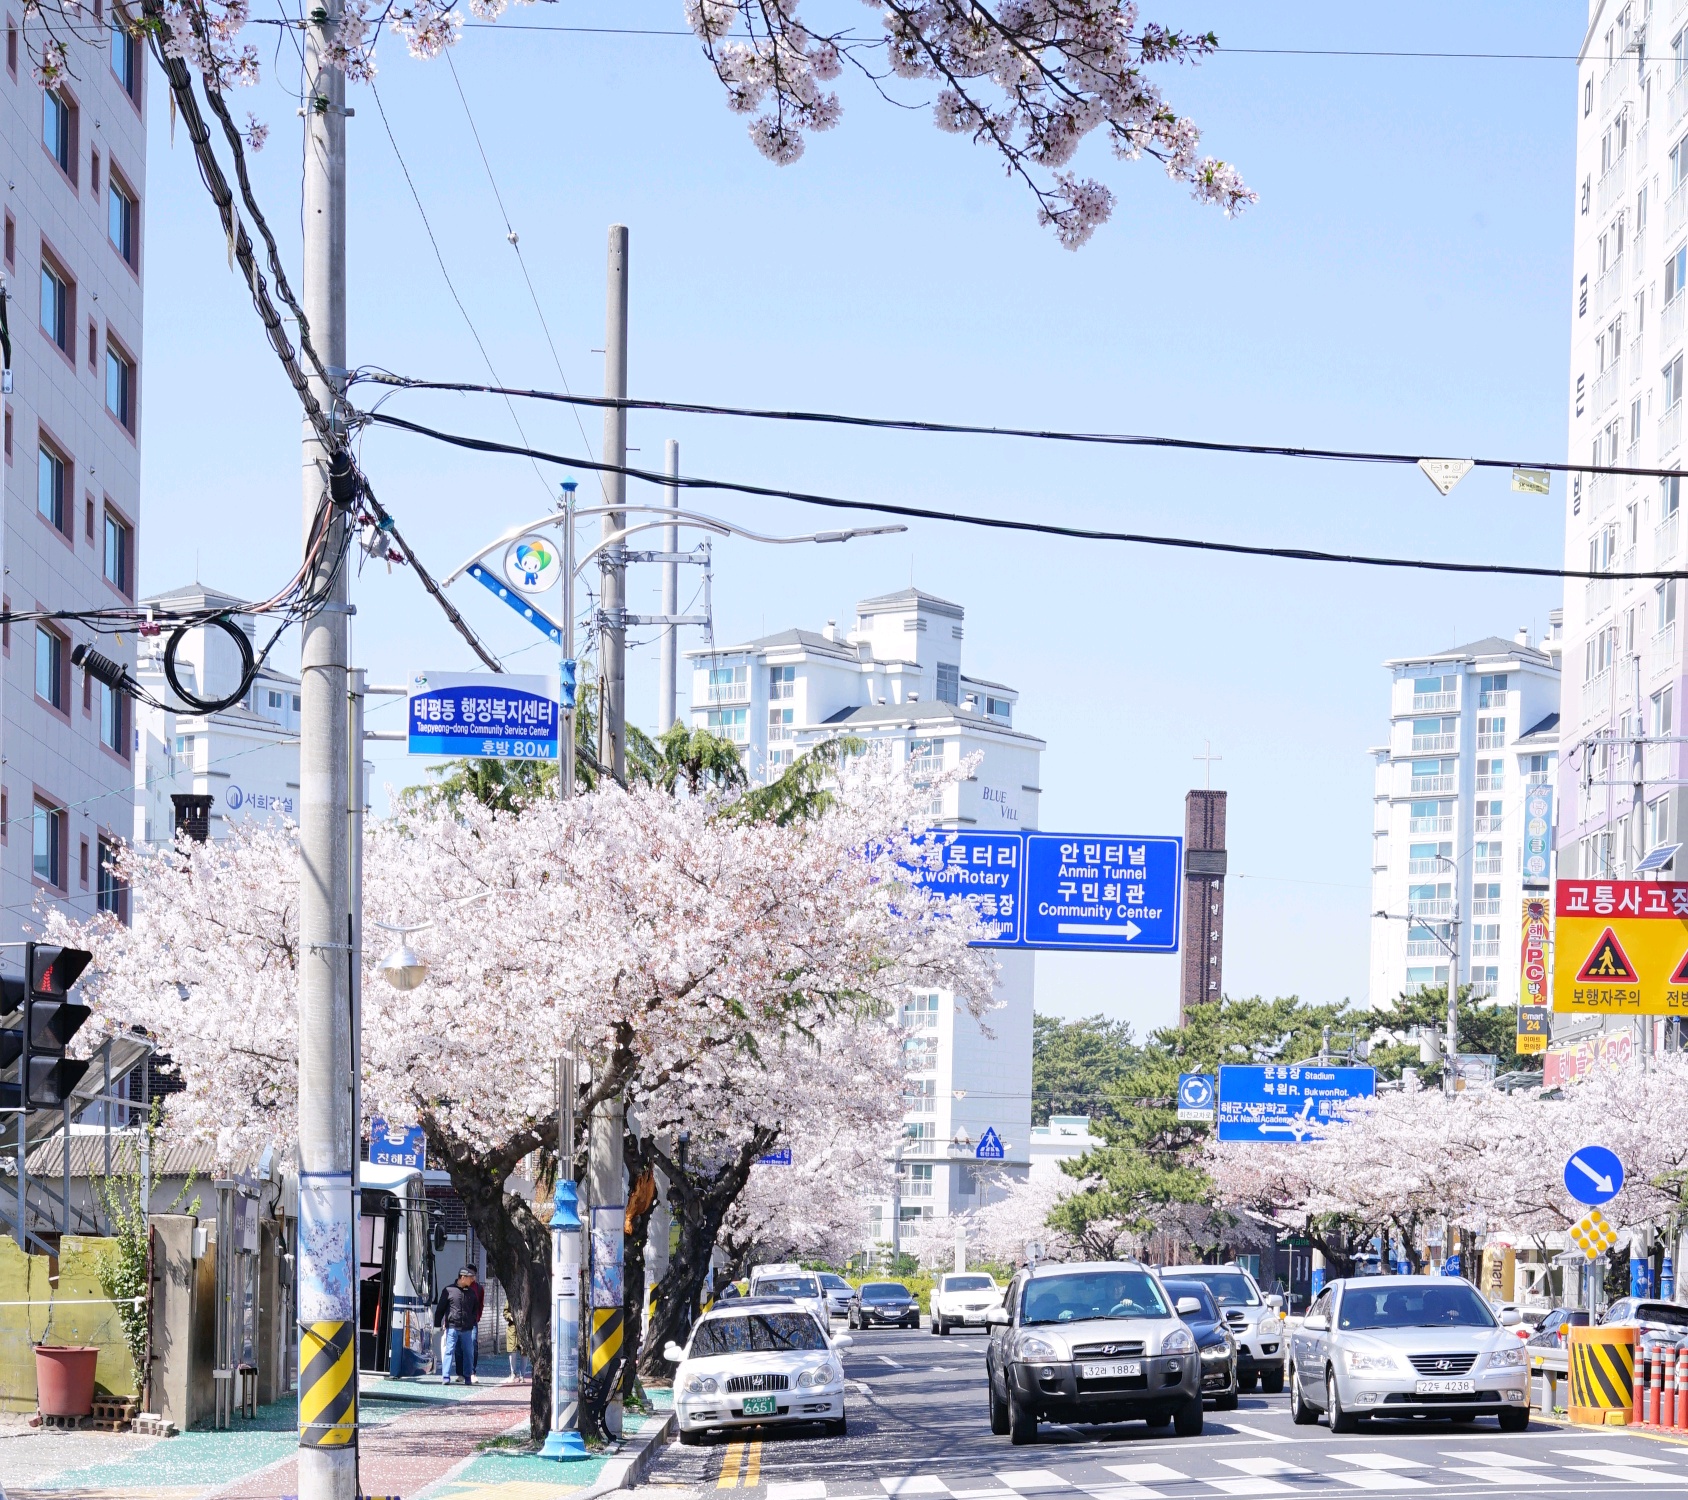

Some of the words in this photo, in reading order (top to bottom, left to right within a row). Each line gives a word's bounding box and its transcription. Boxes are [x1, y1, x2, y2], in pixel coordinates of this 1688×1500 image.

[414, 697, 456, 721] 태평동
[461, 697, 553, 724] 행정복지센터
[417, 721, 469, 735] Taepyeong-dong
[469, 723, 504, 736] Community
[504, 725, 528, 736] Service
[529, 726, 550, 737] Center
[481, 740, 510, 754] 후방
[513, 741, 550, 757] 80M
[983, 786, 1007, 804] BLUE
[1001, 805, 1018, 821] VILL
[1059, 842, 1147, 866] 안민터널
[959, 869, 1010, 889] Rotary
[1057, 864, 1099, 879] Anmin
[1102, 865, 1147, 880] Tunnel
[1057, 881, 1146, 904] 구민회관
[1038, 902, 1113, 921] Community
[1116, 904, 1163, 919] Center
[1571, 988, 1641, 1007] 보행자주의
[1522, 1012, 1544, 1020] emart
[1526, 1020, 1541, 1031] 24
[1263, 1066, 1301, 1080] 운동장
[1304, 1071, 1335, 1081] Stadium
[377, 1153, 417, 1166] 진해점
[1112, 1364, 1135, 1375] 1882
[1444, 1381, 1470, 1391] 4238
[744, 1402, 773, 1413] 6651
